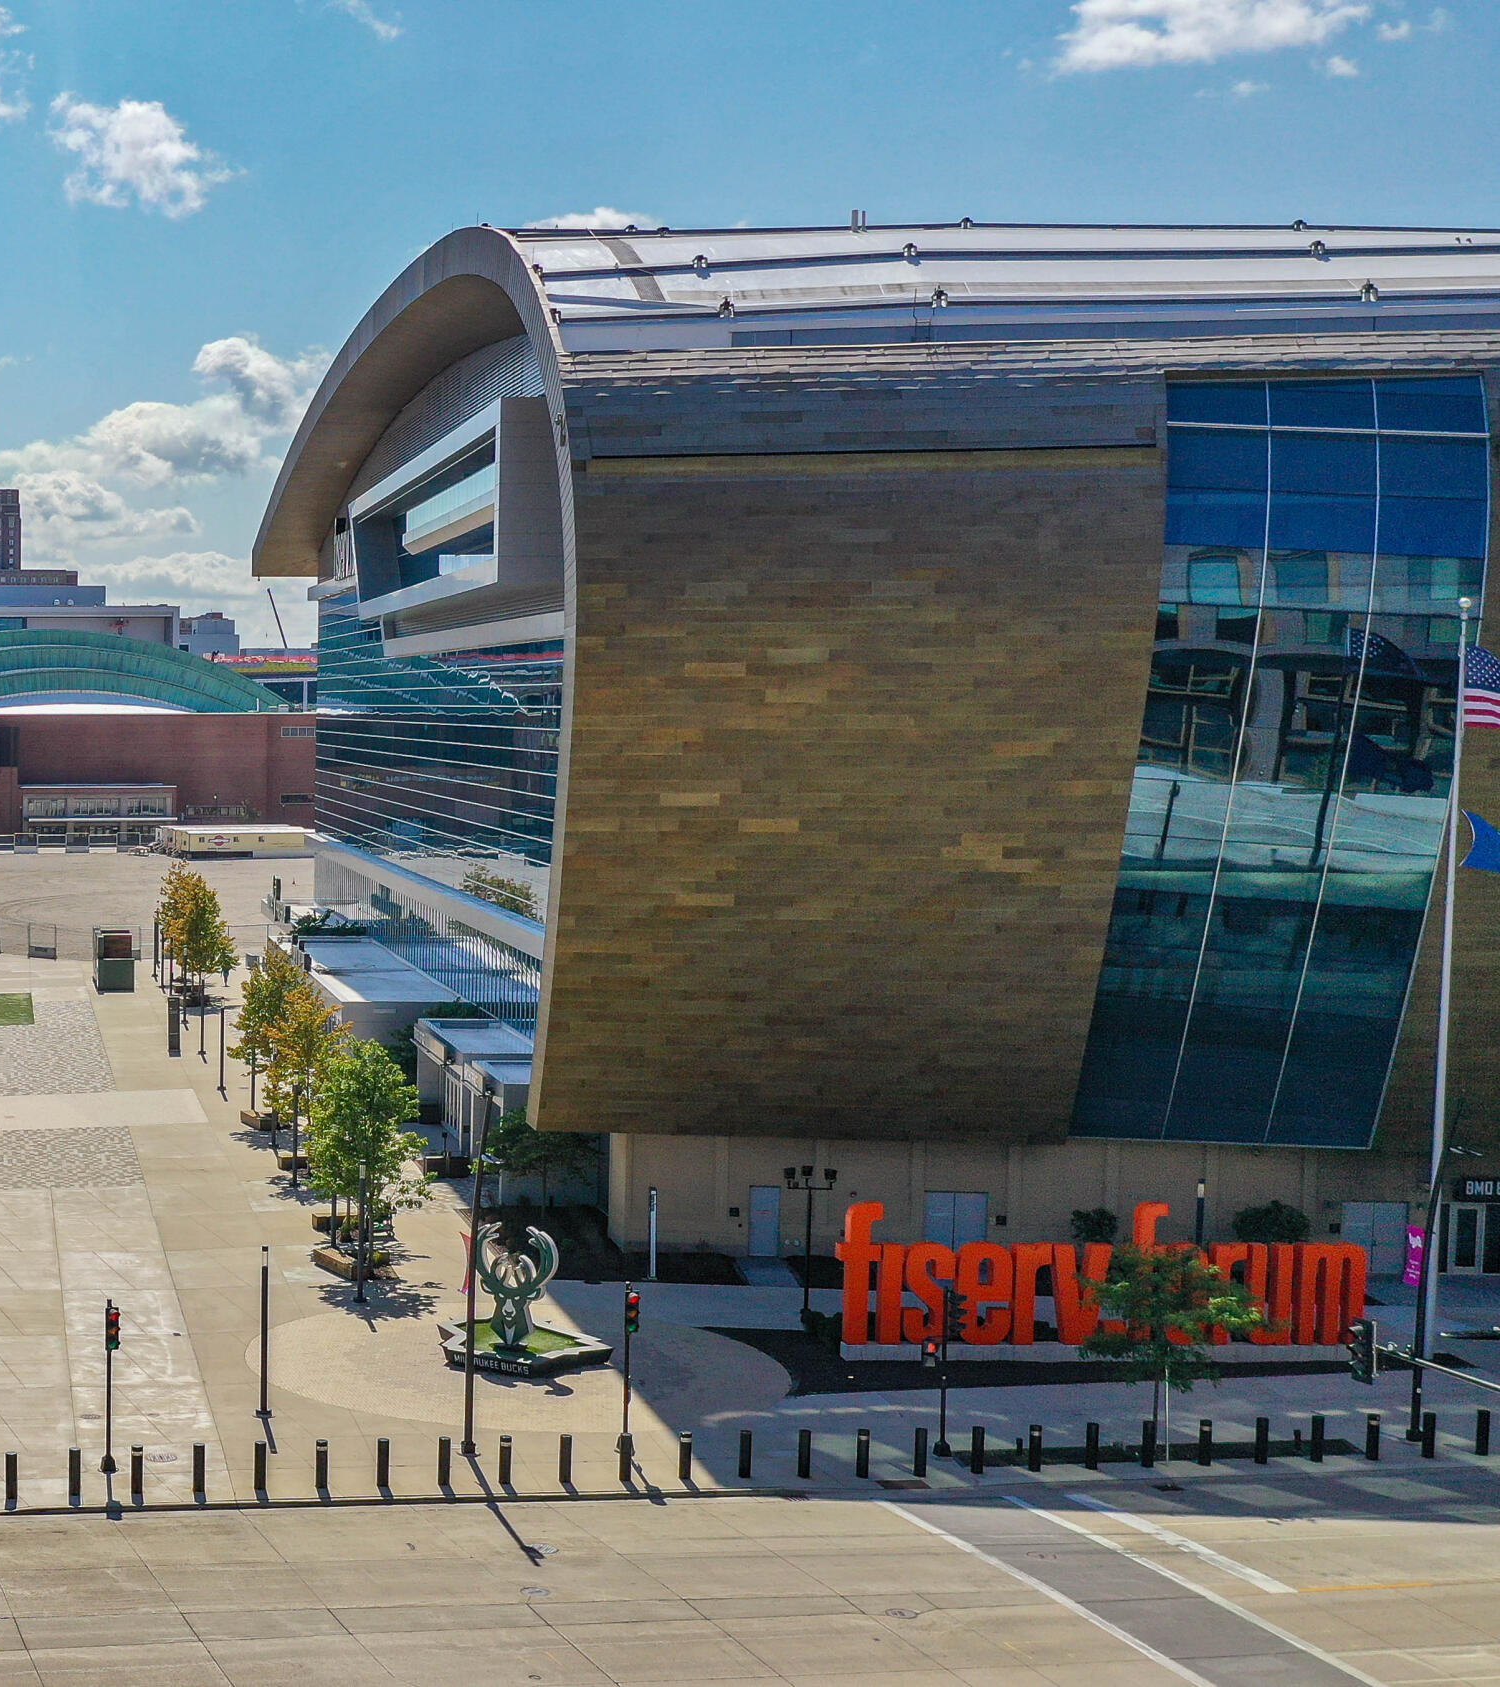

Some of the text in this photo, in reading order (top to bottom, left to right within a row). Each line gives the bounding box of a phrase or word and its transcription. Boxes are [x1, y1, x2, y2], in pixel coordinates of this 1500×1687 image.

[1465, 1181, 1493, 1195] BMO
[453, 1353, 529, 1375] MILAUKEE BUCKS
